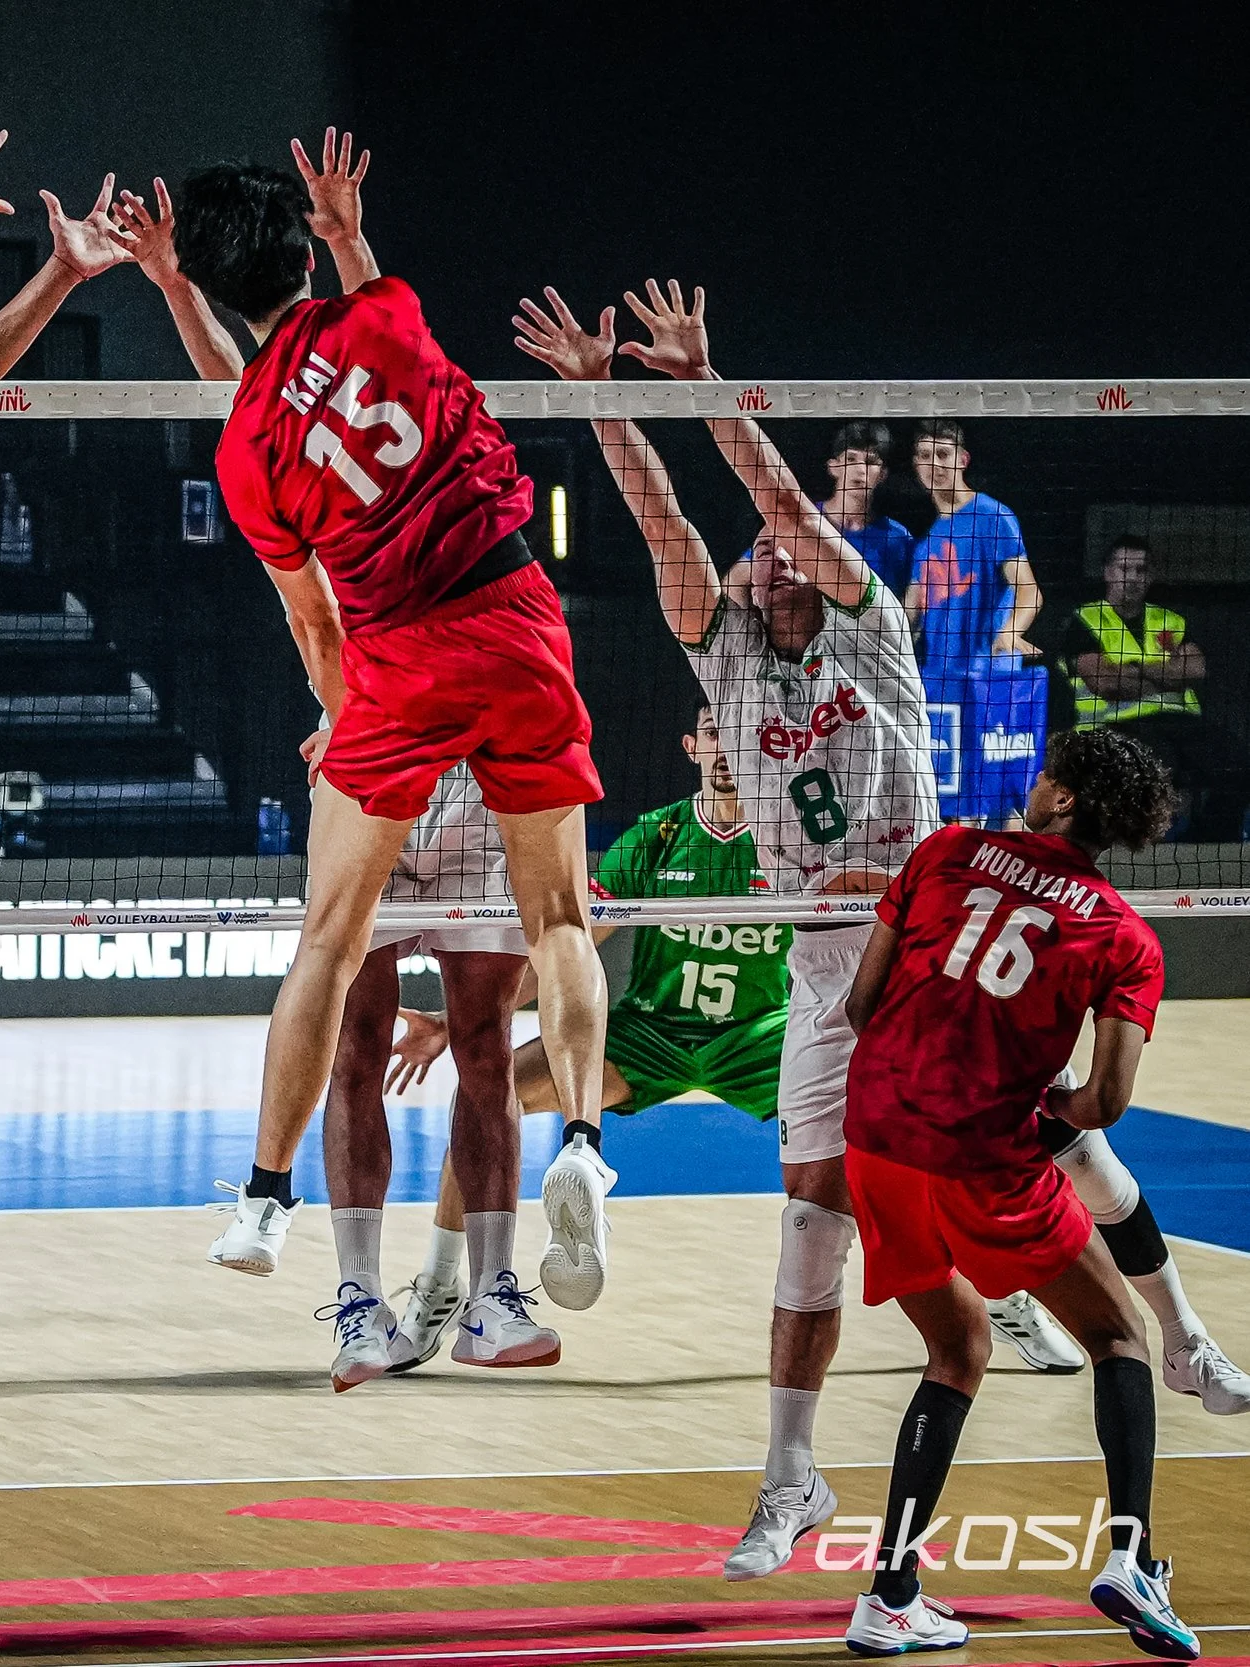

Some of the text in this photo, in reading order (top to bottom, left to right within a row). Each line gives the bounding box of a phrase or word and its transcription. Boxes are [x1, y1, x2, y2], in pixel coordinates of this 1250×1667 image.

[281, 351, 338, 416] KAI
[736, 385, 773, 411] VNL
[1097, 385, 1133, 411] VNL
[305, 363, 424, 507] 15
[788, 767, 849, 845] 8
[969, 843, 1100, 920] MURAYAMA
[70, 913, 185, 927] VNL VOLLEYBALL
[942, 887, 1055, 1000] 16
[679, 960, 739, 1016] 15
